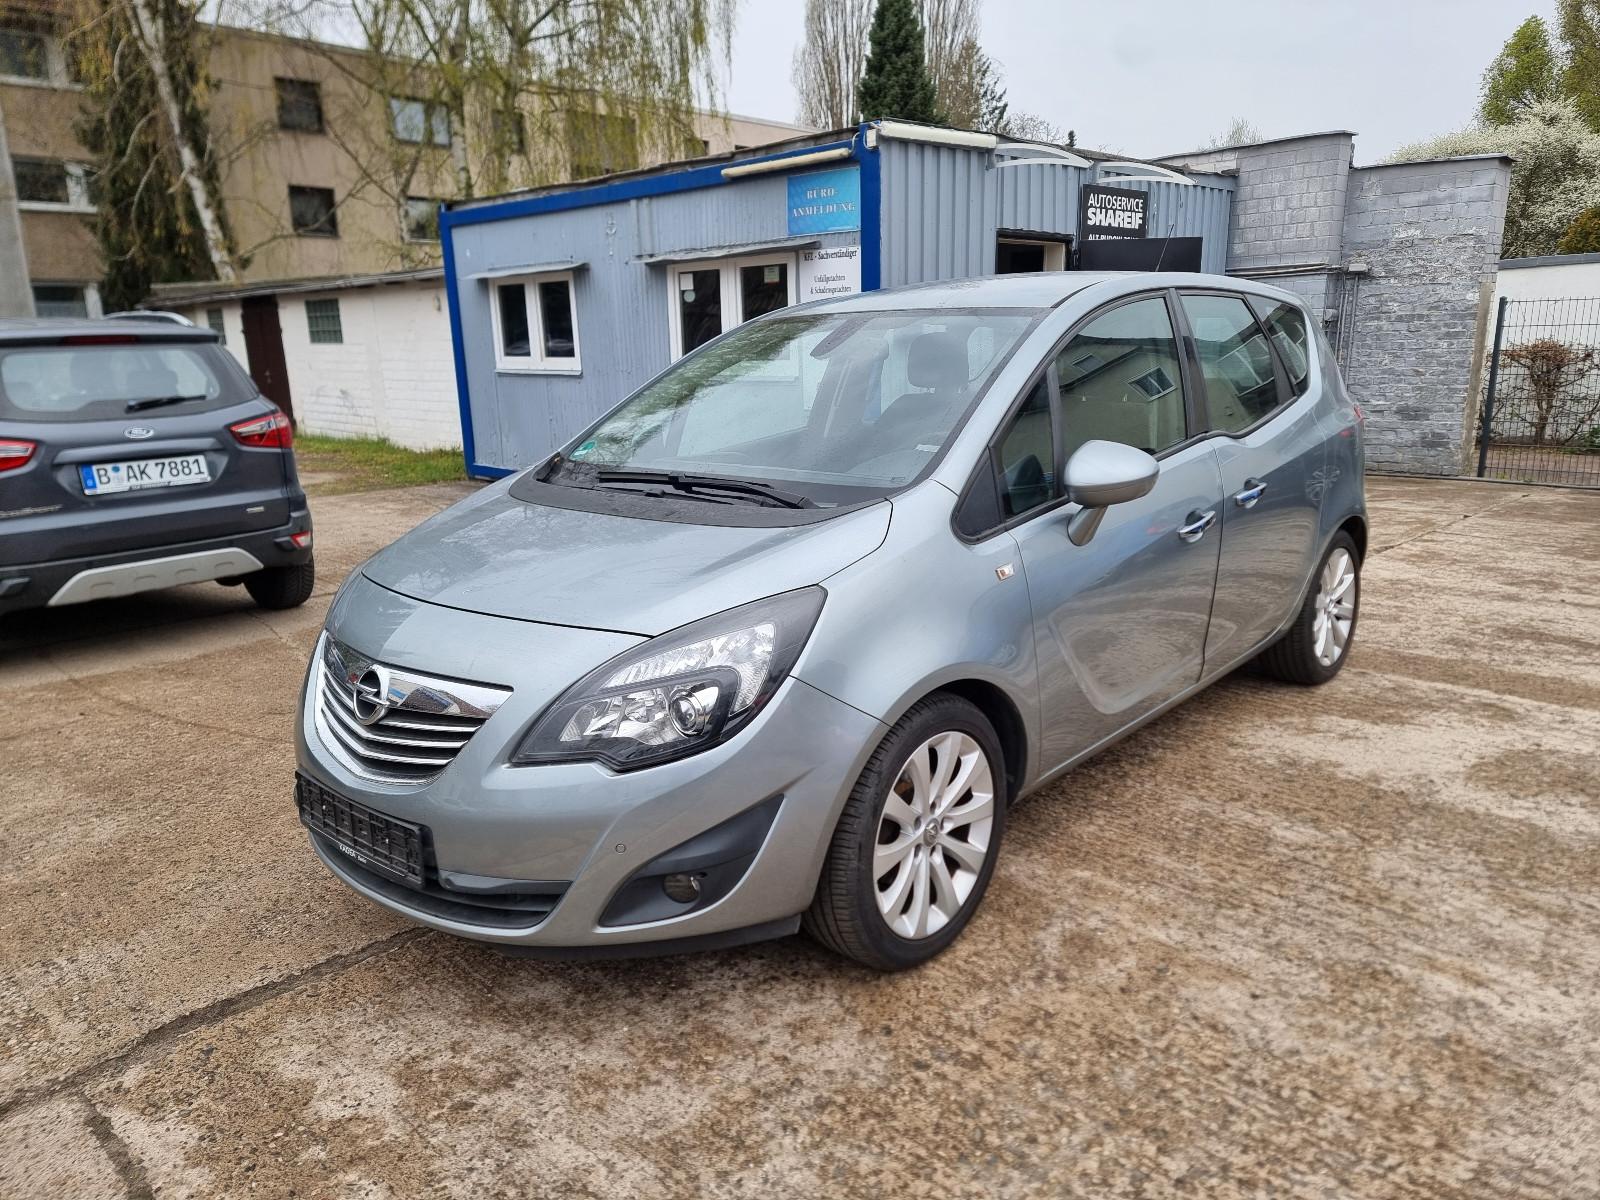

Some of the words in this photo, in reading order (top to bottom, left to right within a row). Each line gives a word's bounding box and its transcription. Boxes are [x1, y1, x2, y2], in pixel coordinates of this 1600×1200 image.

[792, 202, 855, 217] ANMELDUNG
[1088, 193, 1143, 212] AUTOSERVICE
[1087, 207, 1143, 230] SHAREIF
[817, 248, 857, 260] Sachverständiger
[96, 467, 111, 485] B
[126, 463, 152, 482] AK
[154, 458, 205, 479] 7881
